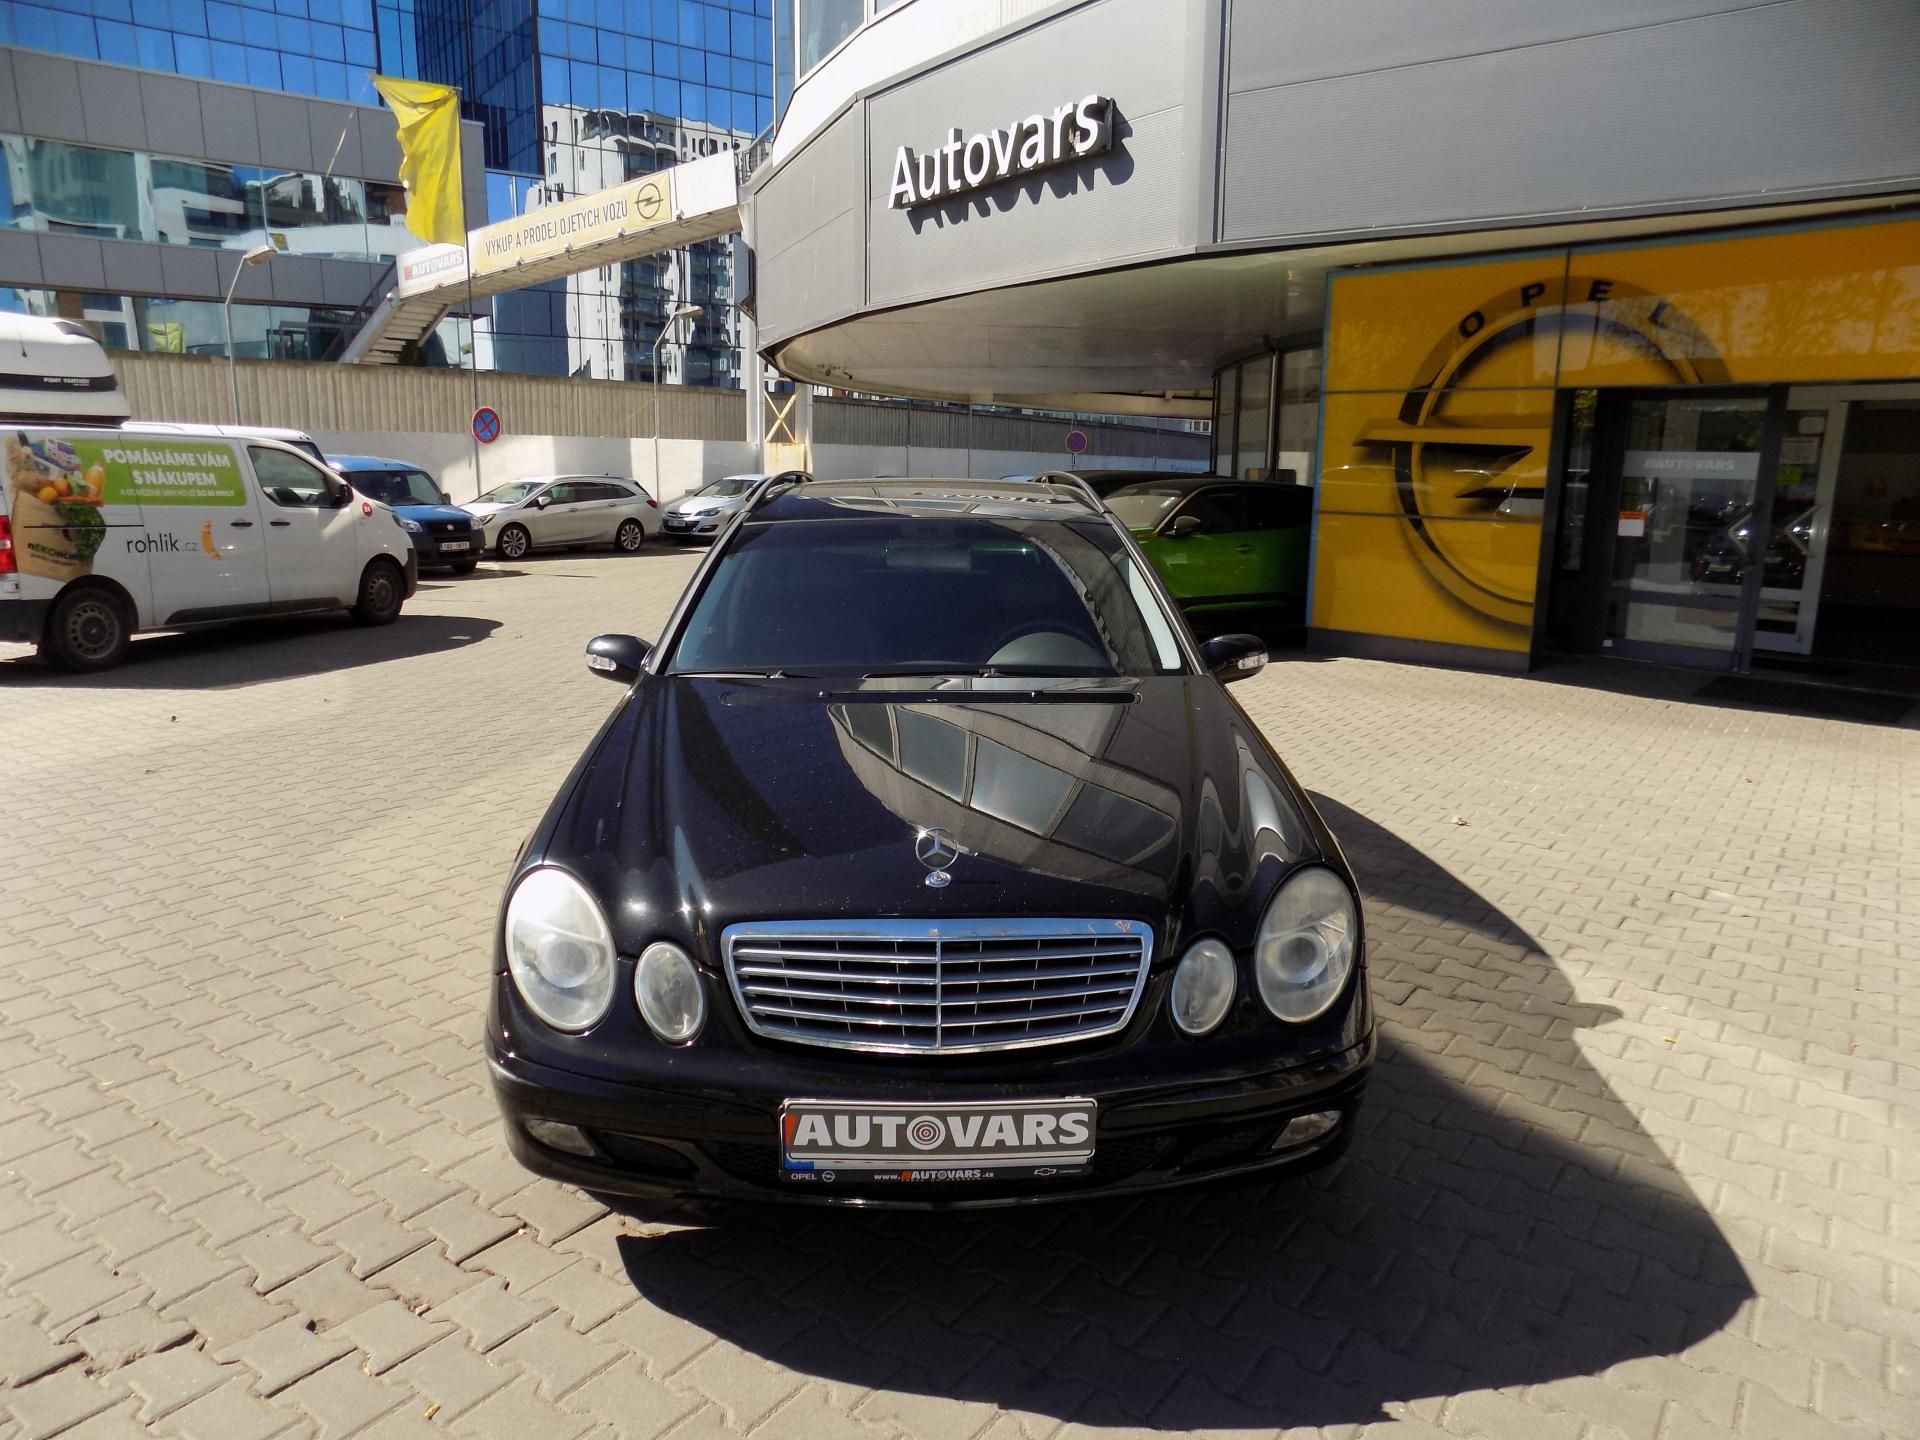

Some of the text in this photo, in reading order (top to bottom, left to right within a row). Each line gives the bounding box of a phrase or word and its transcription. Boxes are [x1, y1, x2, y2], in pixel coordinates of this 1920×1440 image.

[888, 94, 1098, 209] Autovars
[486, 233, 513, 256] VÝKUP
[516, 233, 522, 248] A
[524, 221, 557, 245] PRODEJ
[560, 208, 599, 236] OJETÝCH
[412, 252, 464, 275] AUTOVARS
[1458, 279, 1671, 338] OPEL
[103, 448, 231, 467] POMÁHÁME VÁM
[1655, 459, 1735, 471] AUTOVARS
[132, 469, 217, 485] S NÁKUPEM
[793, 1112, 1089, 1150] AUTOVARS
